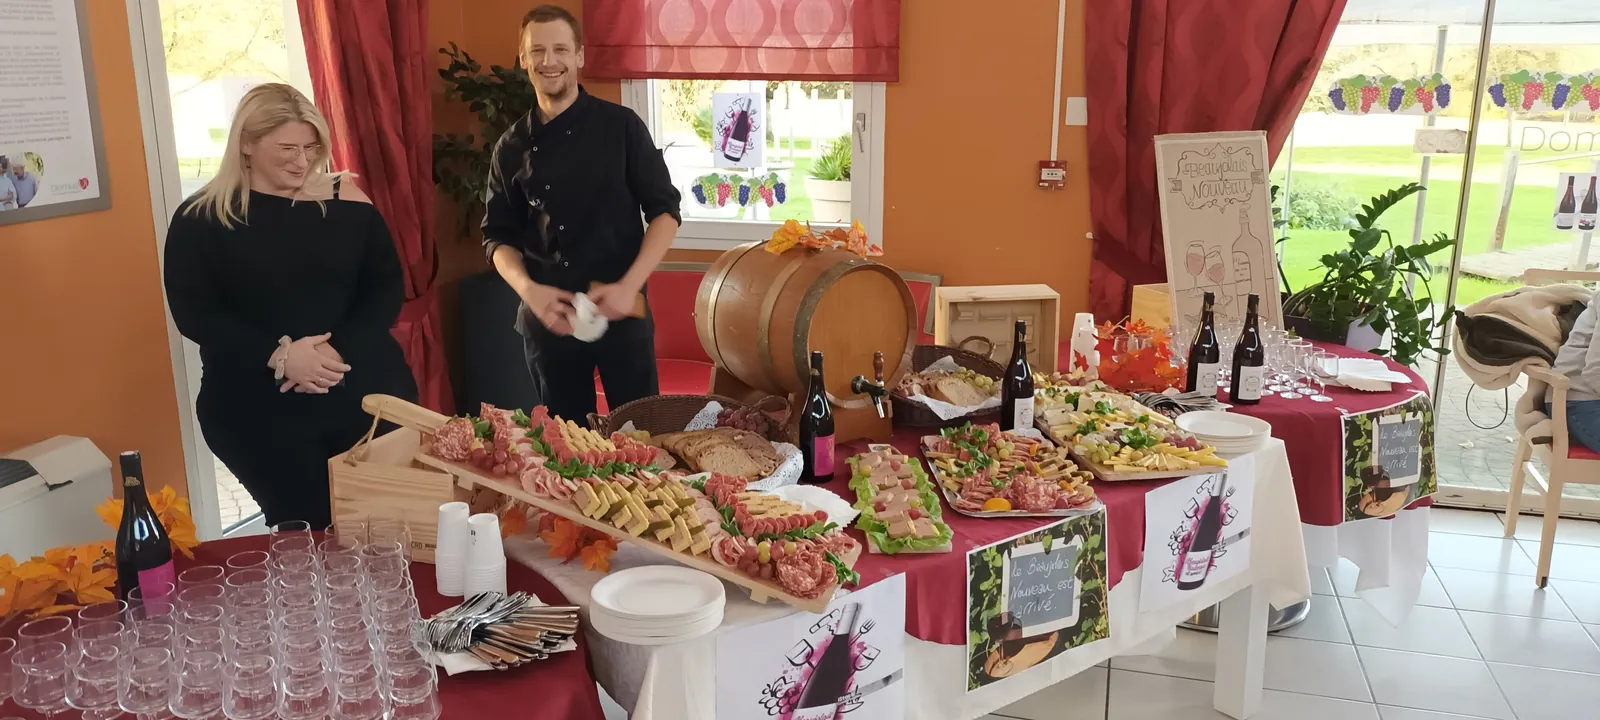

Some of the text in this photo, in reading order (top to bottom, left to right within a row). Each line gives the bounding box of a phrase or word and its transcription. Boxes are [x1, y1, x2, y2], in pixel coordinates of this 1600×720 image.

[1182, 154, 1248, 181] Beaujolais
[1189, 180, 1248, 201] Nouveau
[1011, 553, 1069, 578] Le Beaujolais
[1010, 576, 1075, 600] Nouveau est
